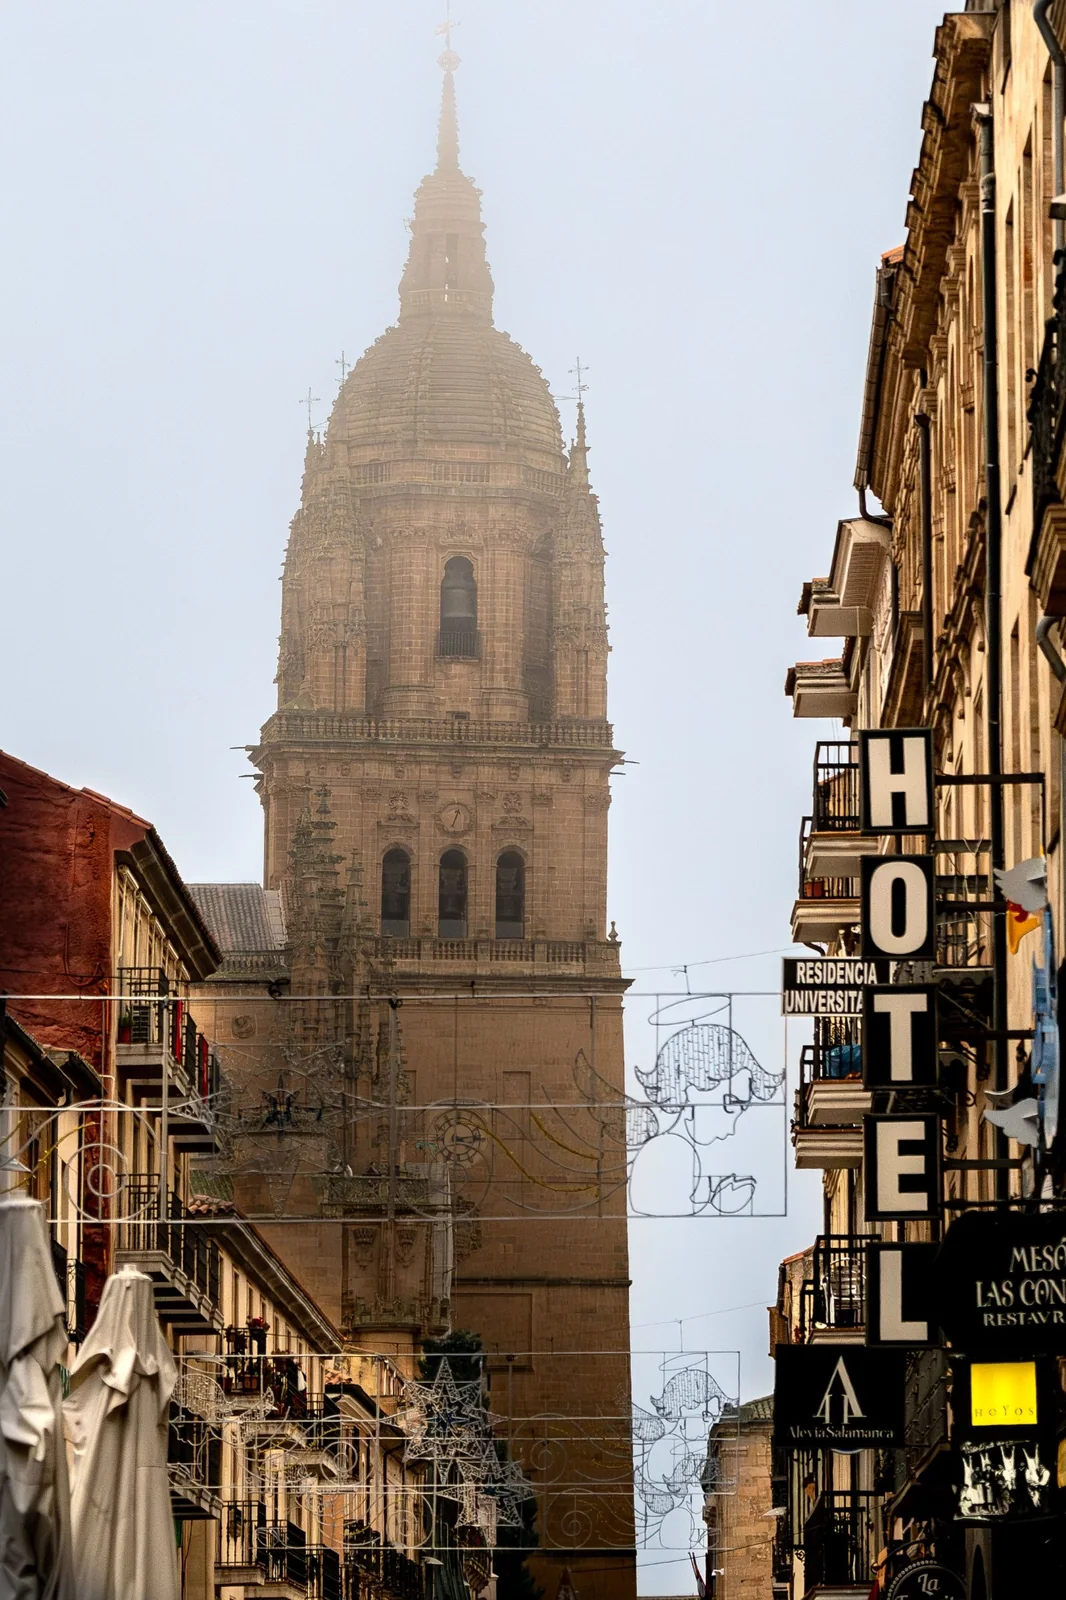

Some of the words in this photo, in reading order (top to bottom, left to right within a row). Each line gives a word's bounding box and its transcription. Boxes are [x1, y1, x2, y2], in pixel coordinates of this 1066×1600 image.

[796, 961, 878, 985] RESIDENCIA
[867, 737, 929, 1341] HOTEL
[975, 1275, 1015, 1308] LAS
[1019, 1274, 1066, 1306] CON
[974, 1405, 1034, 1418] HOYOS
[917, 1573, 942, 1596] La
